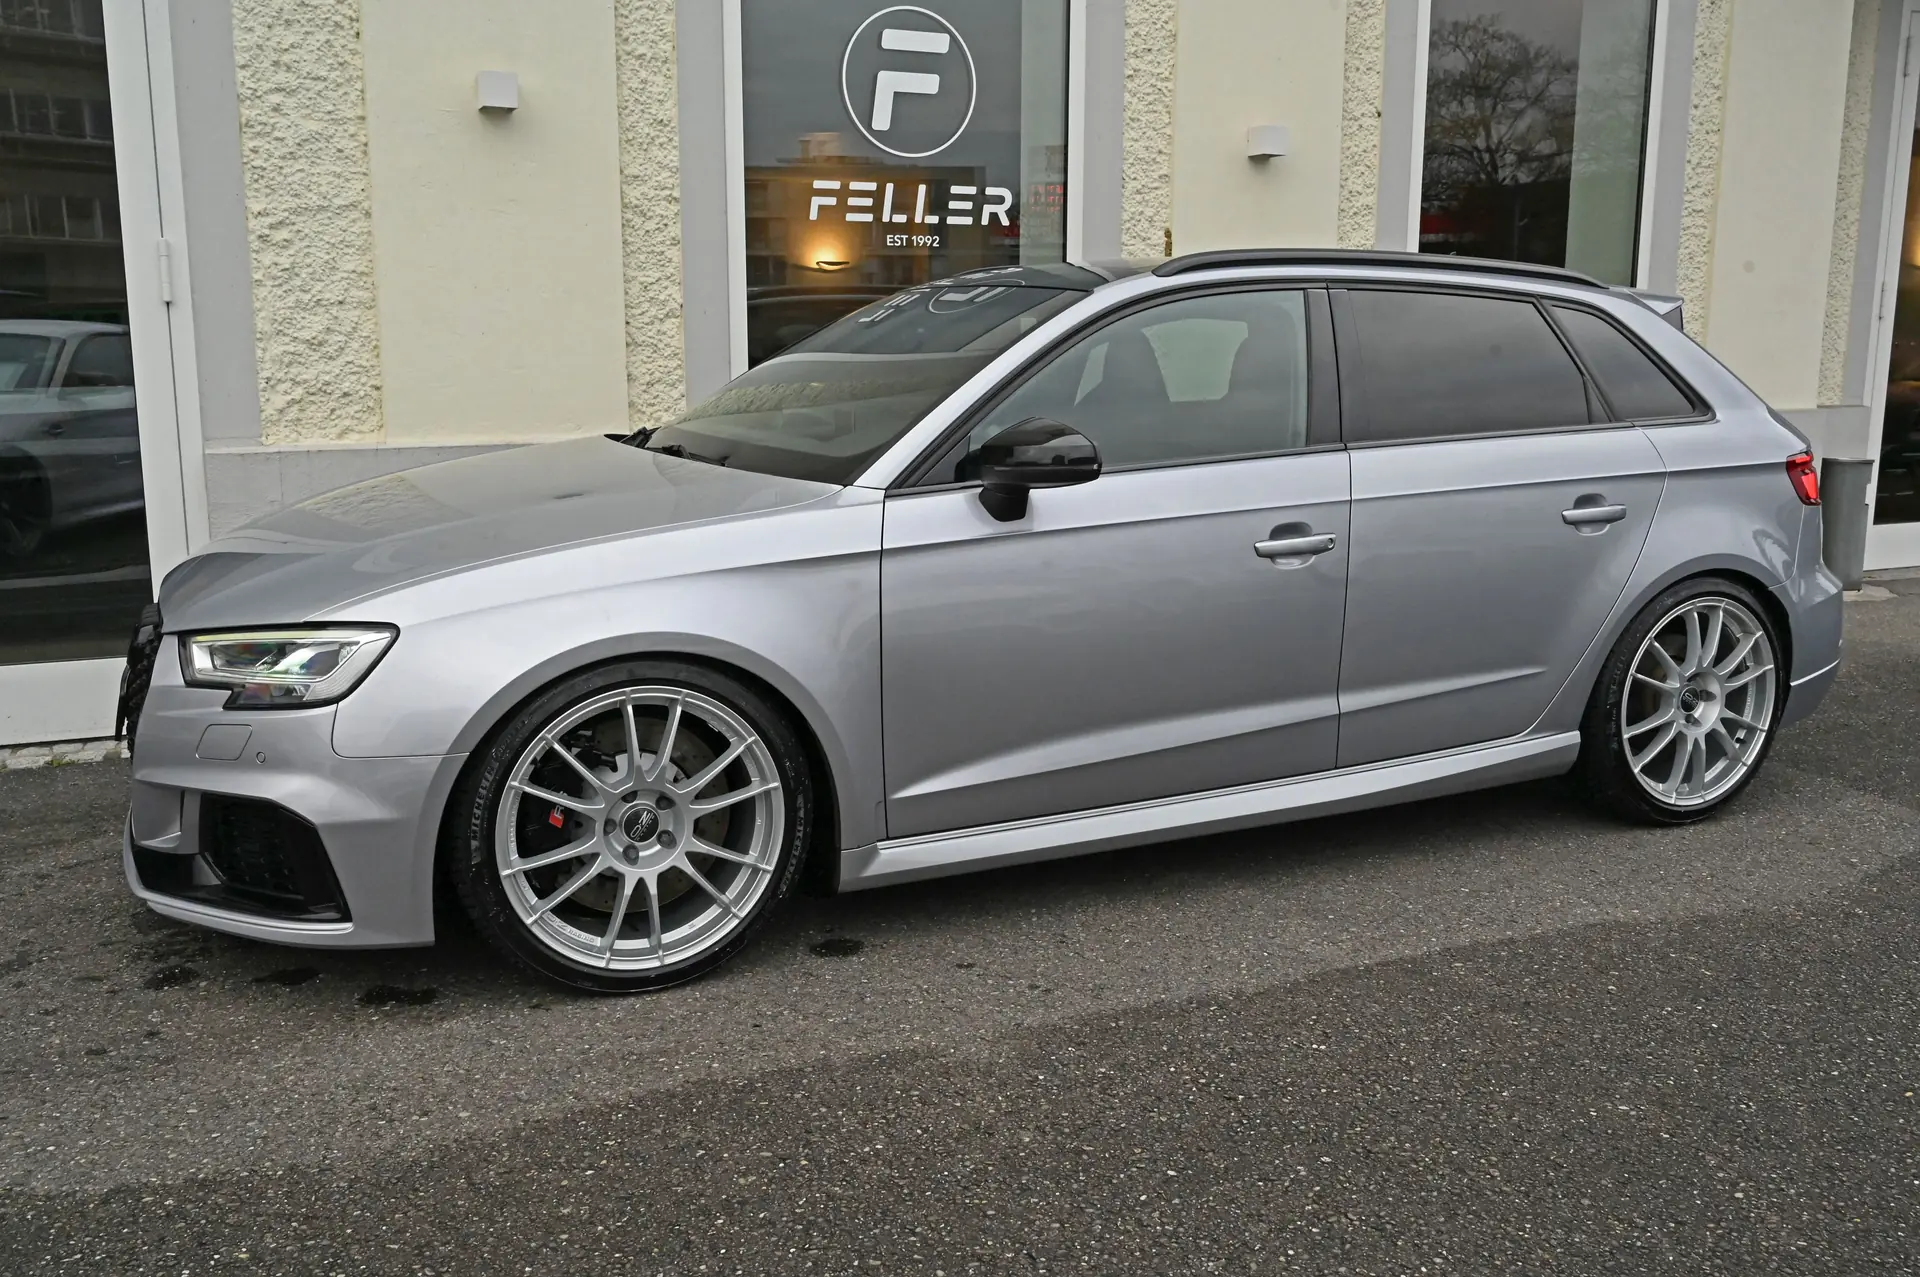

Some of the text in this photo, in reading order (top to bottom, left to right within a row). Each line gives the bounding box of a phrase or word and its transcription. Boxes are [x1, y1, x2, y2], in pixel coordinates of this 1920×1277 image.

[871, 28, 951, 131] F
[809, 179, 1013, 226] FELLER
[886, 234, 940, 248] EST 1992
